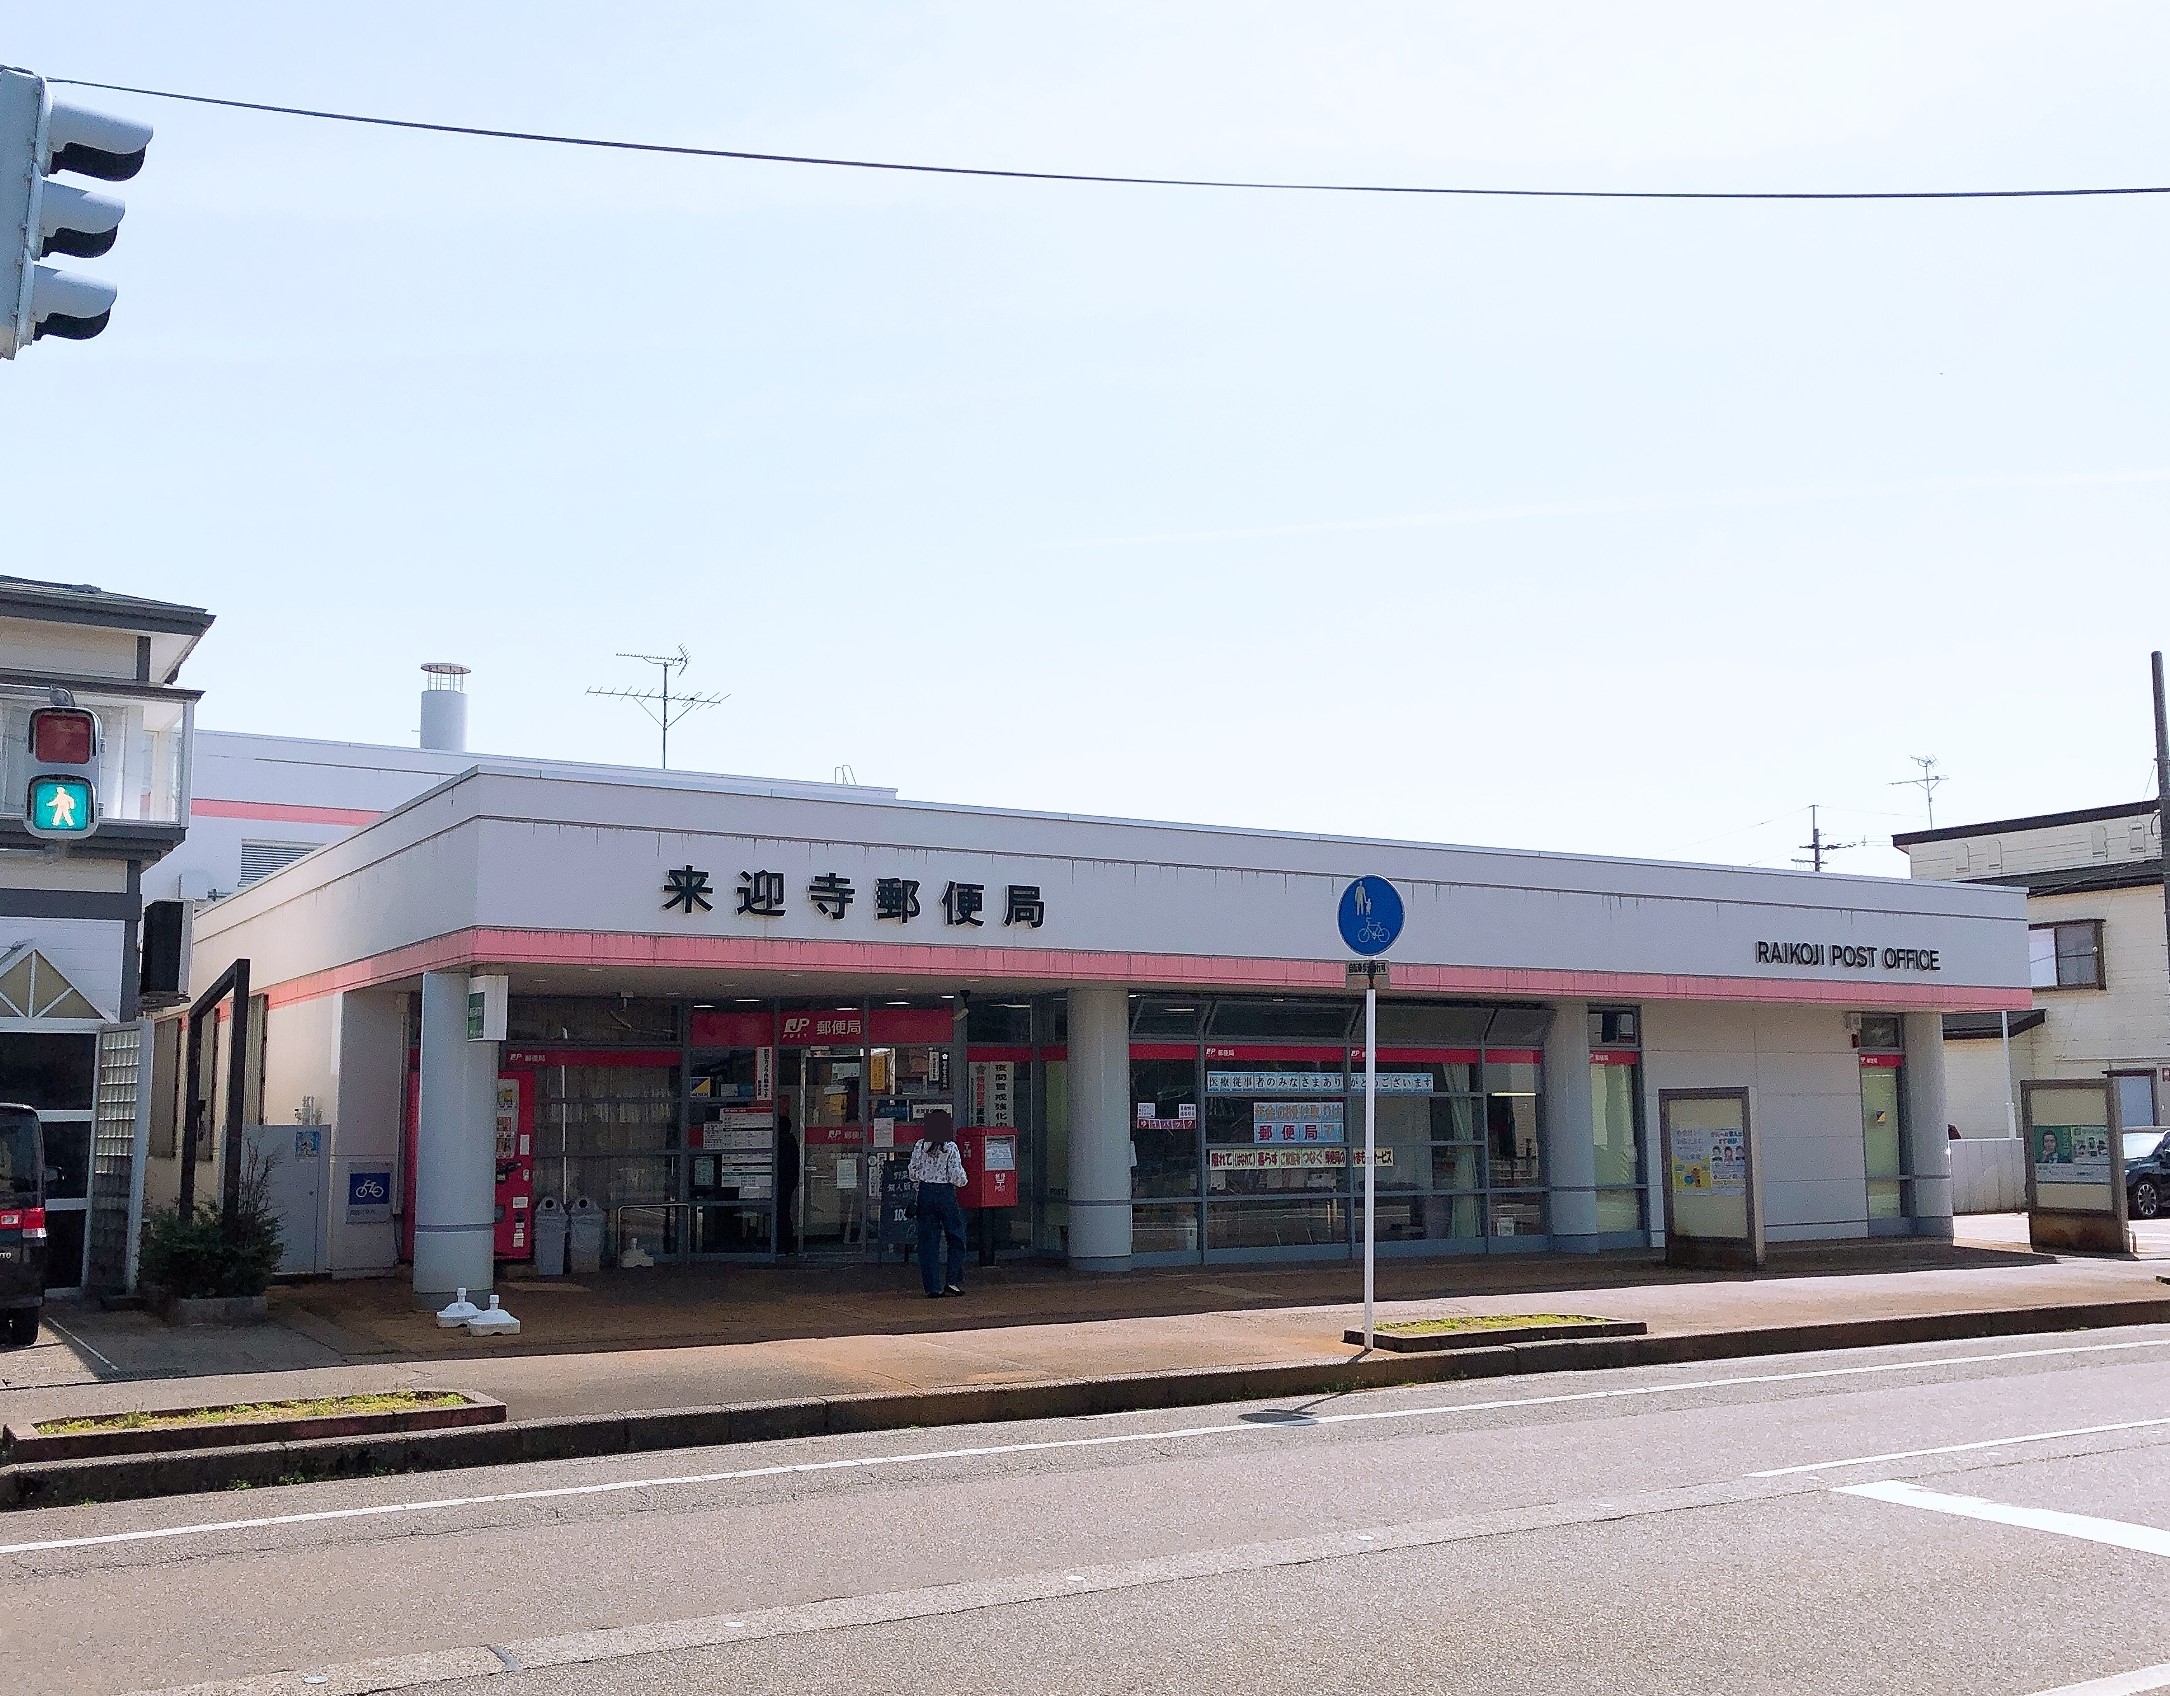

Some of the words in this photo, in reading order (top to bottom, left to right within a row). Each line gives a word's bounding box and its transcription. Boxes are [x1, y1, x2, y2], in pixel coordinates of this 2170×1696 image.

[662, 864, 1046, 929] 来迎寺郵便局
[1756, 940, 1826, 966] RAIKOJI
[1830, 944, 1878, 969] POST
[1883, 947, 1941, 971] OFFICE
[816, 1019, 862, 1036] 郵便局
